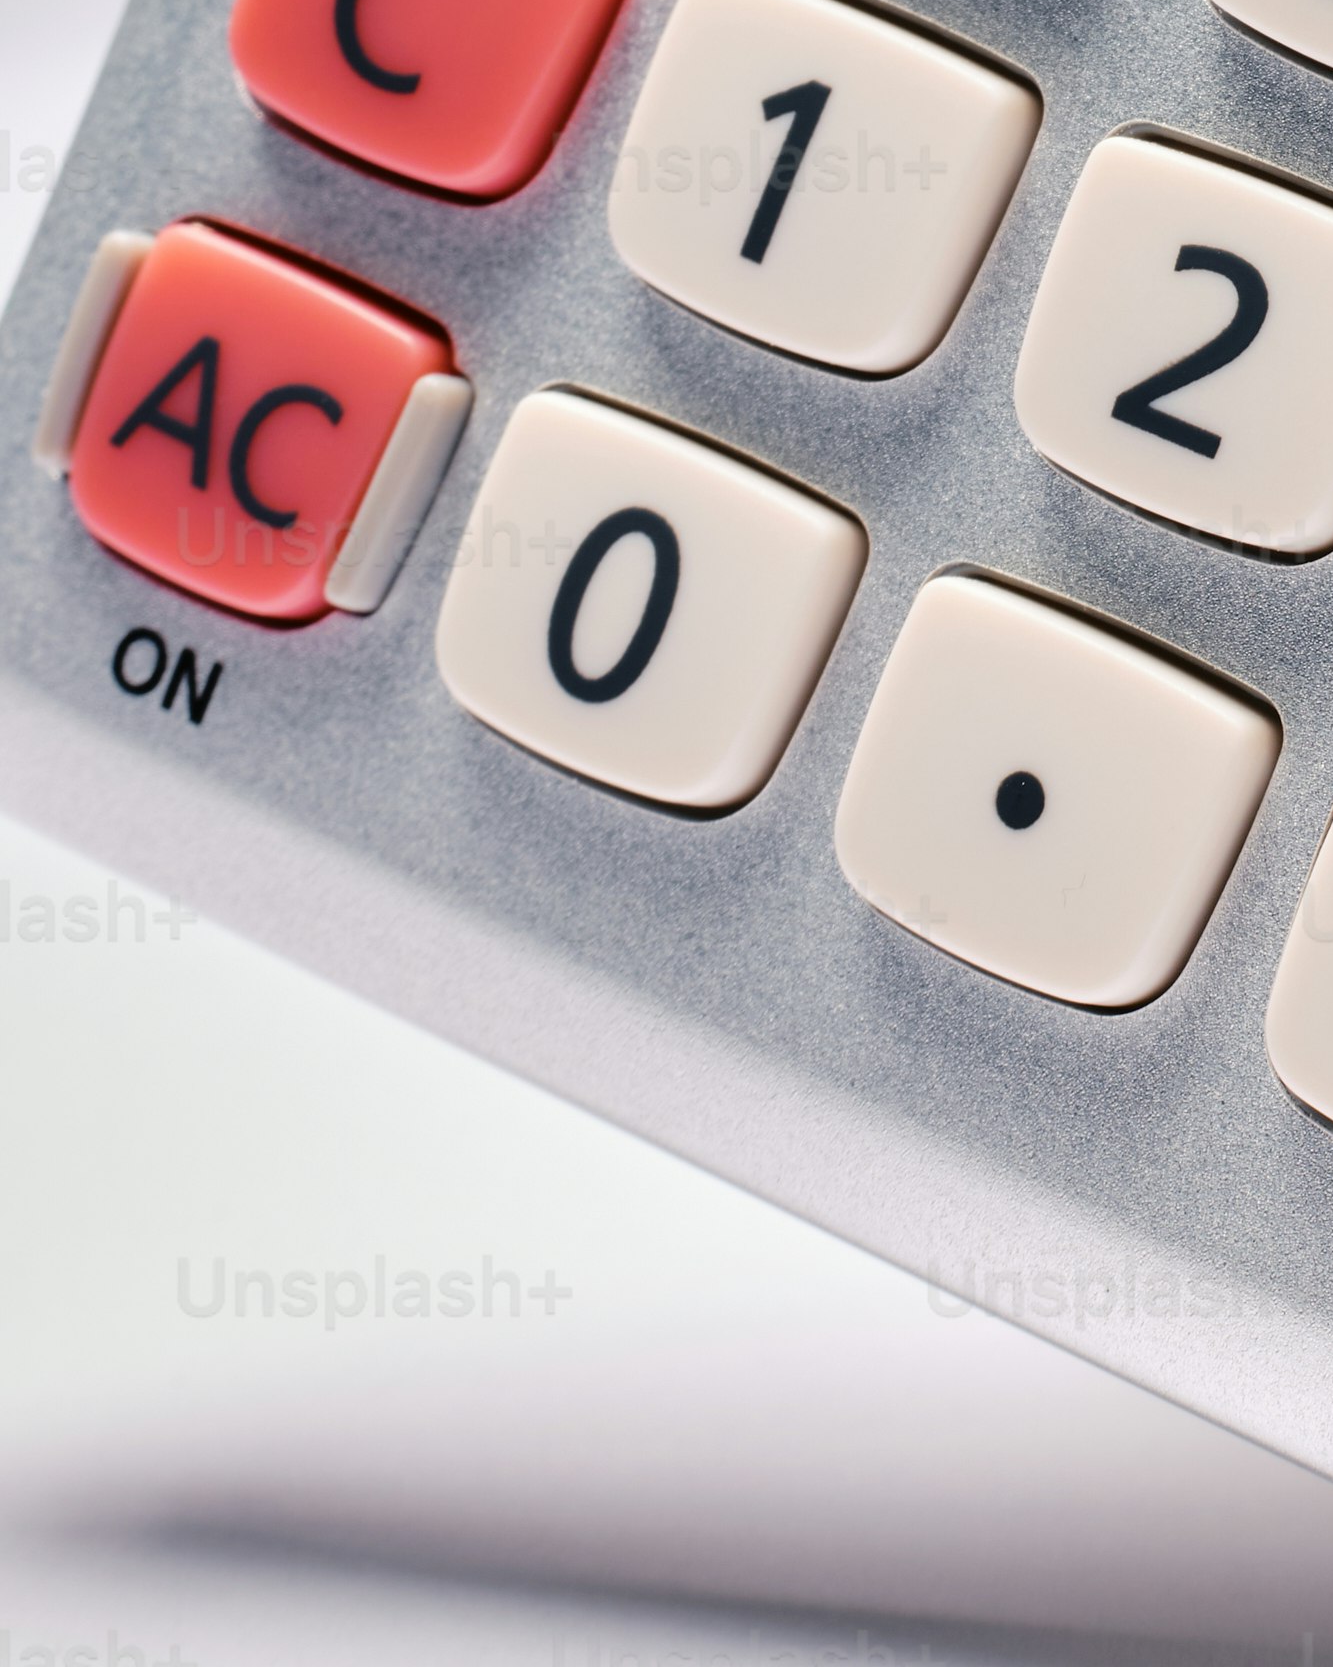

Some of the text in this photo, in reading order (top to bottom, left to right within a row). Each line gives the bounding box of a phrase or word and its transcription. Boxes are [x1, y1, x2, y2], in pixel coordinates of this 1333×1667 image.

[740, 81, 831, 264] 1
[110, 337, 343, 530] AC
[1111, 245, 1268, 459] 2
[113, 627, 224, 725] ON
